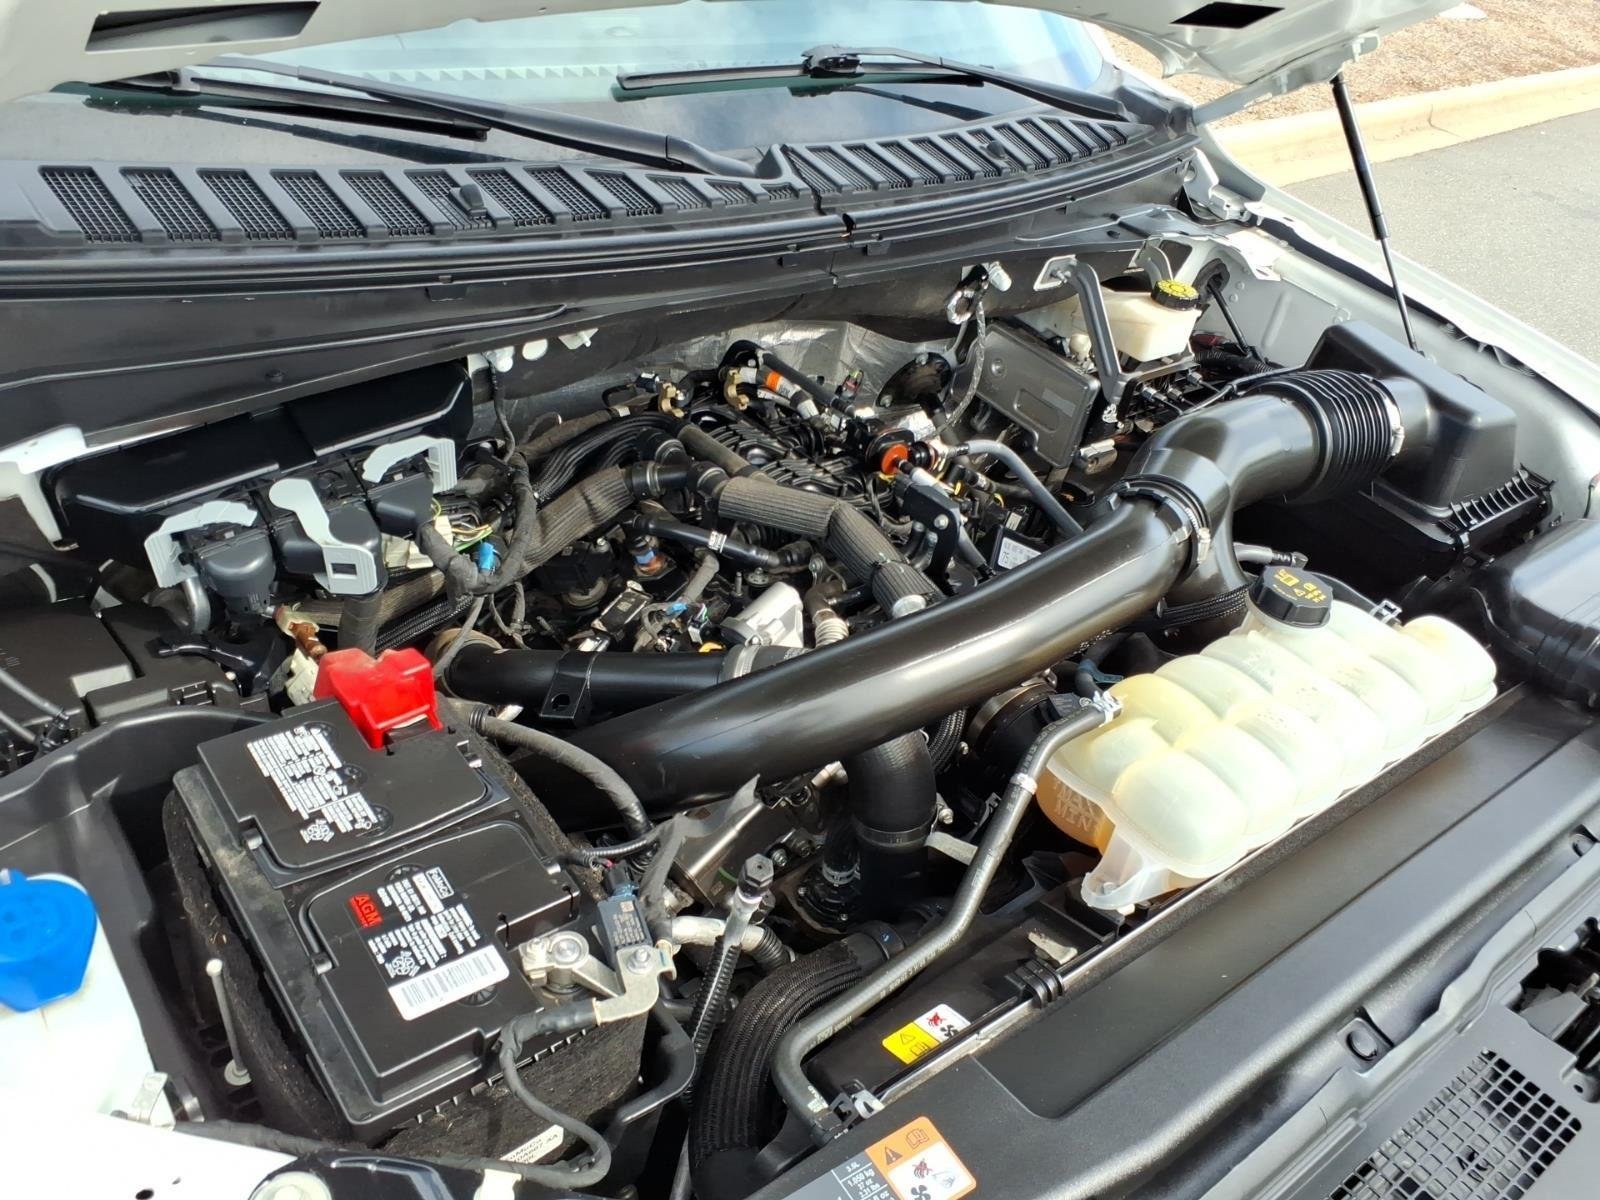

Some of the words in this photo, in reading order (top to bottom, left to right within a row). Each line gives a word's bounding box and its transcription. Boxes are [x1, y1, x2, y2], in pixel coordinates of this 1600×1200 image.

[1053, 798, 1093, 832] MIN
[427, 868, 453, 898] FoMoCo
[355, 893, 382, 927] AGM
[863, 1168, 875, 1177] kg
[880, 1190, 890, 1199] oz
